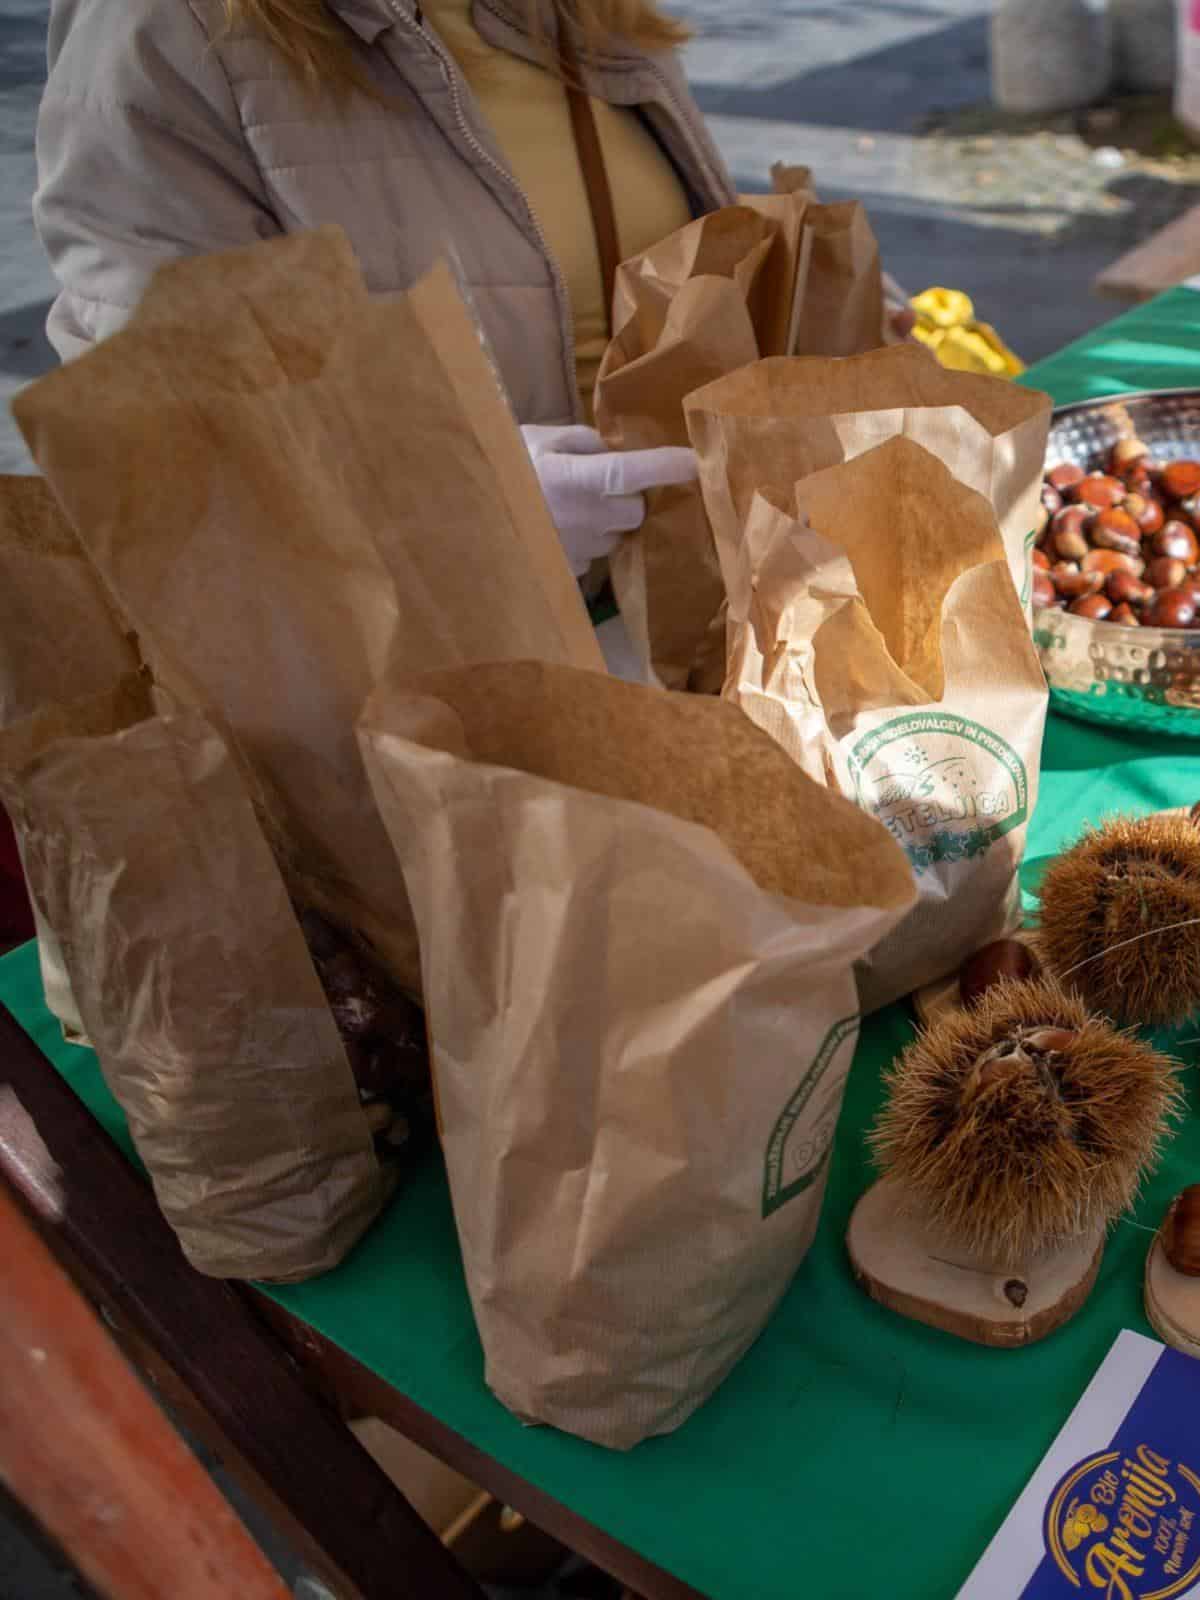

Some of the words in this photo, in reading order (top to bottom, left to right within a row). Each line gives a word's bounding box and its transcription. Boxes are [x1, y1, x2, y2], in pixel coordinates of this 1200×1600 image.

[885, 790, 1010, 839] ETELJICA
[1085, 1443, 1177, 1600] Aronija
[1154, 1514, 1177, 1556] 100%
